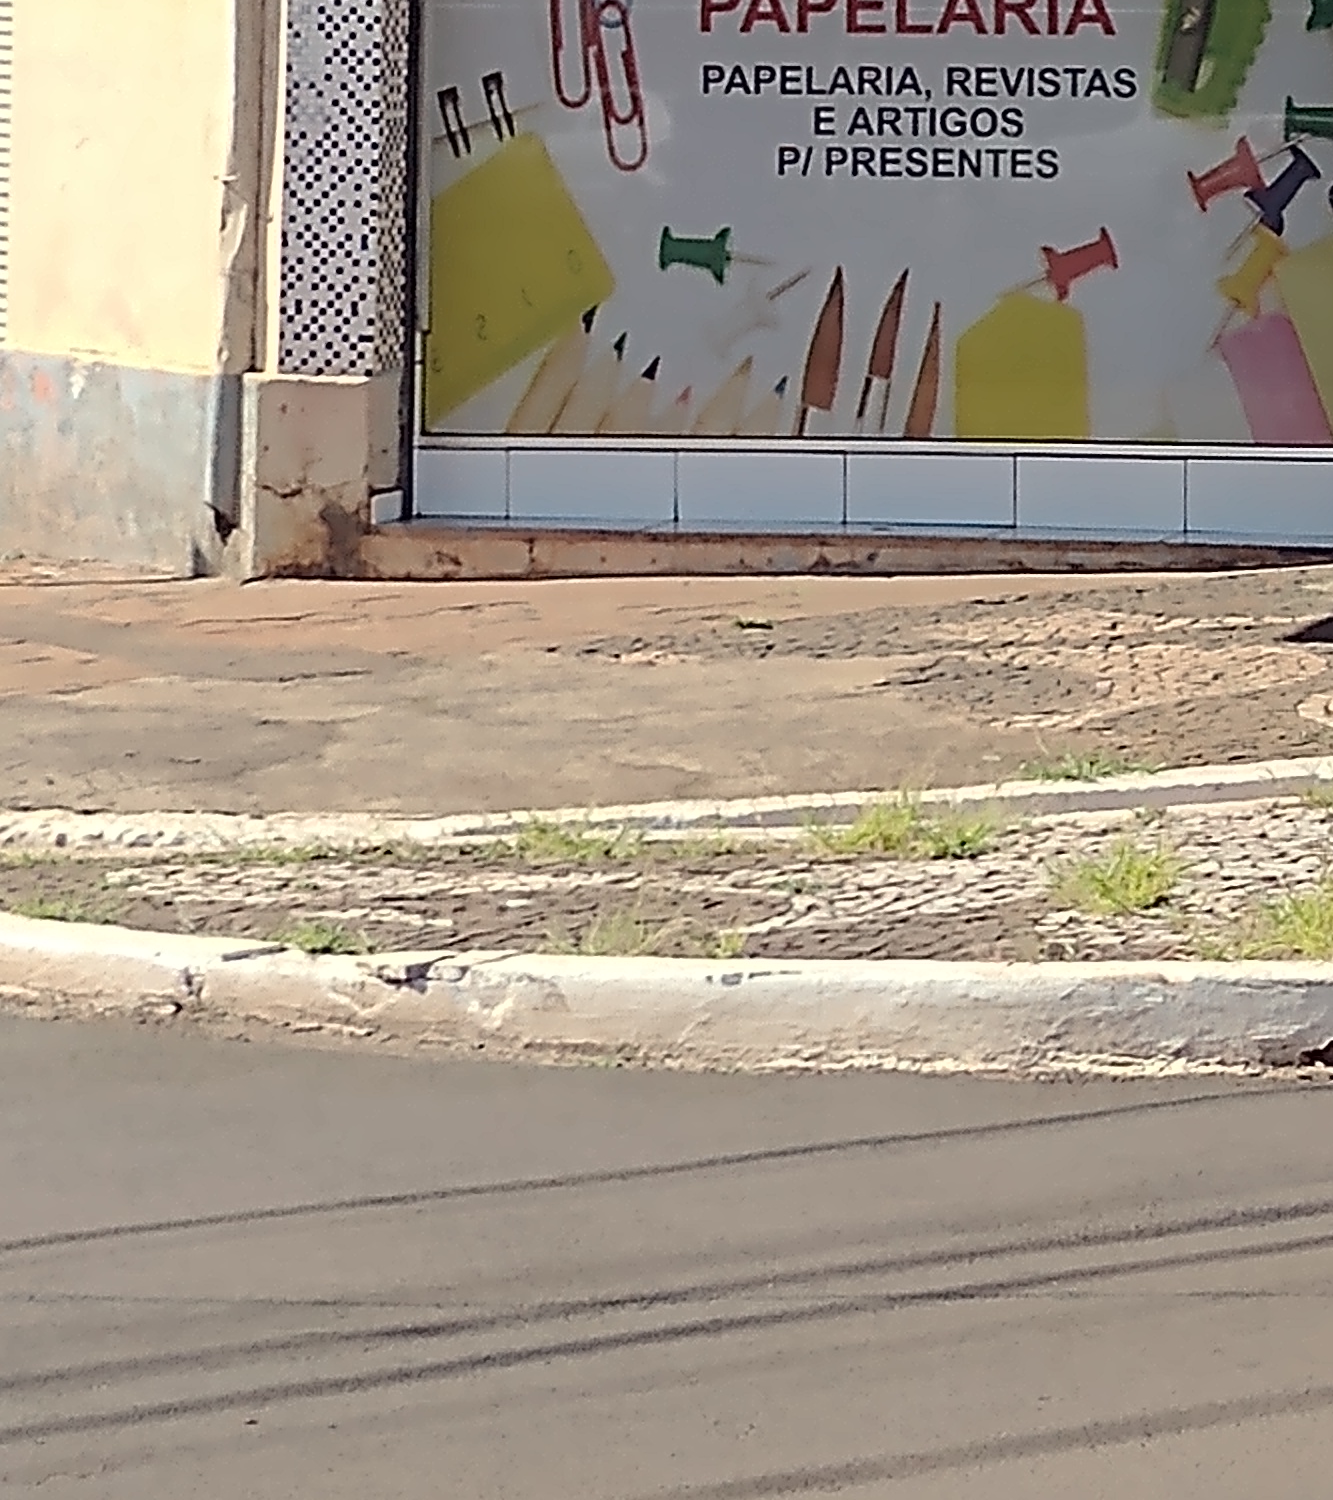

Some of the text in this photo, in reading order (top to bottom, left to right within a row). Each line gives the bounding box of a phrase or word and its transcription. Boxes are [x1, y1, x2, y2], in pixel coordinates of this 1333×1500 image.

[701, 64, 1139, 102] PAPELARIA, REVISTAS
[813, 106, 1026, 139] E ARTIGOS
[777, 145, 1062, 181] P/ PRESENTES
